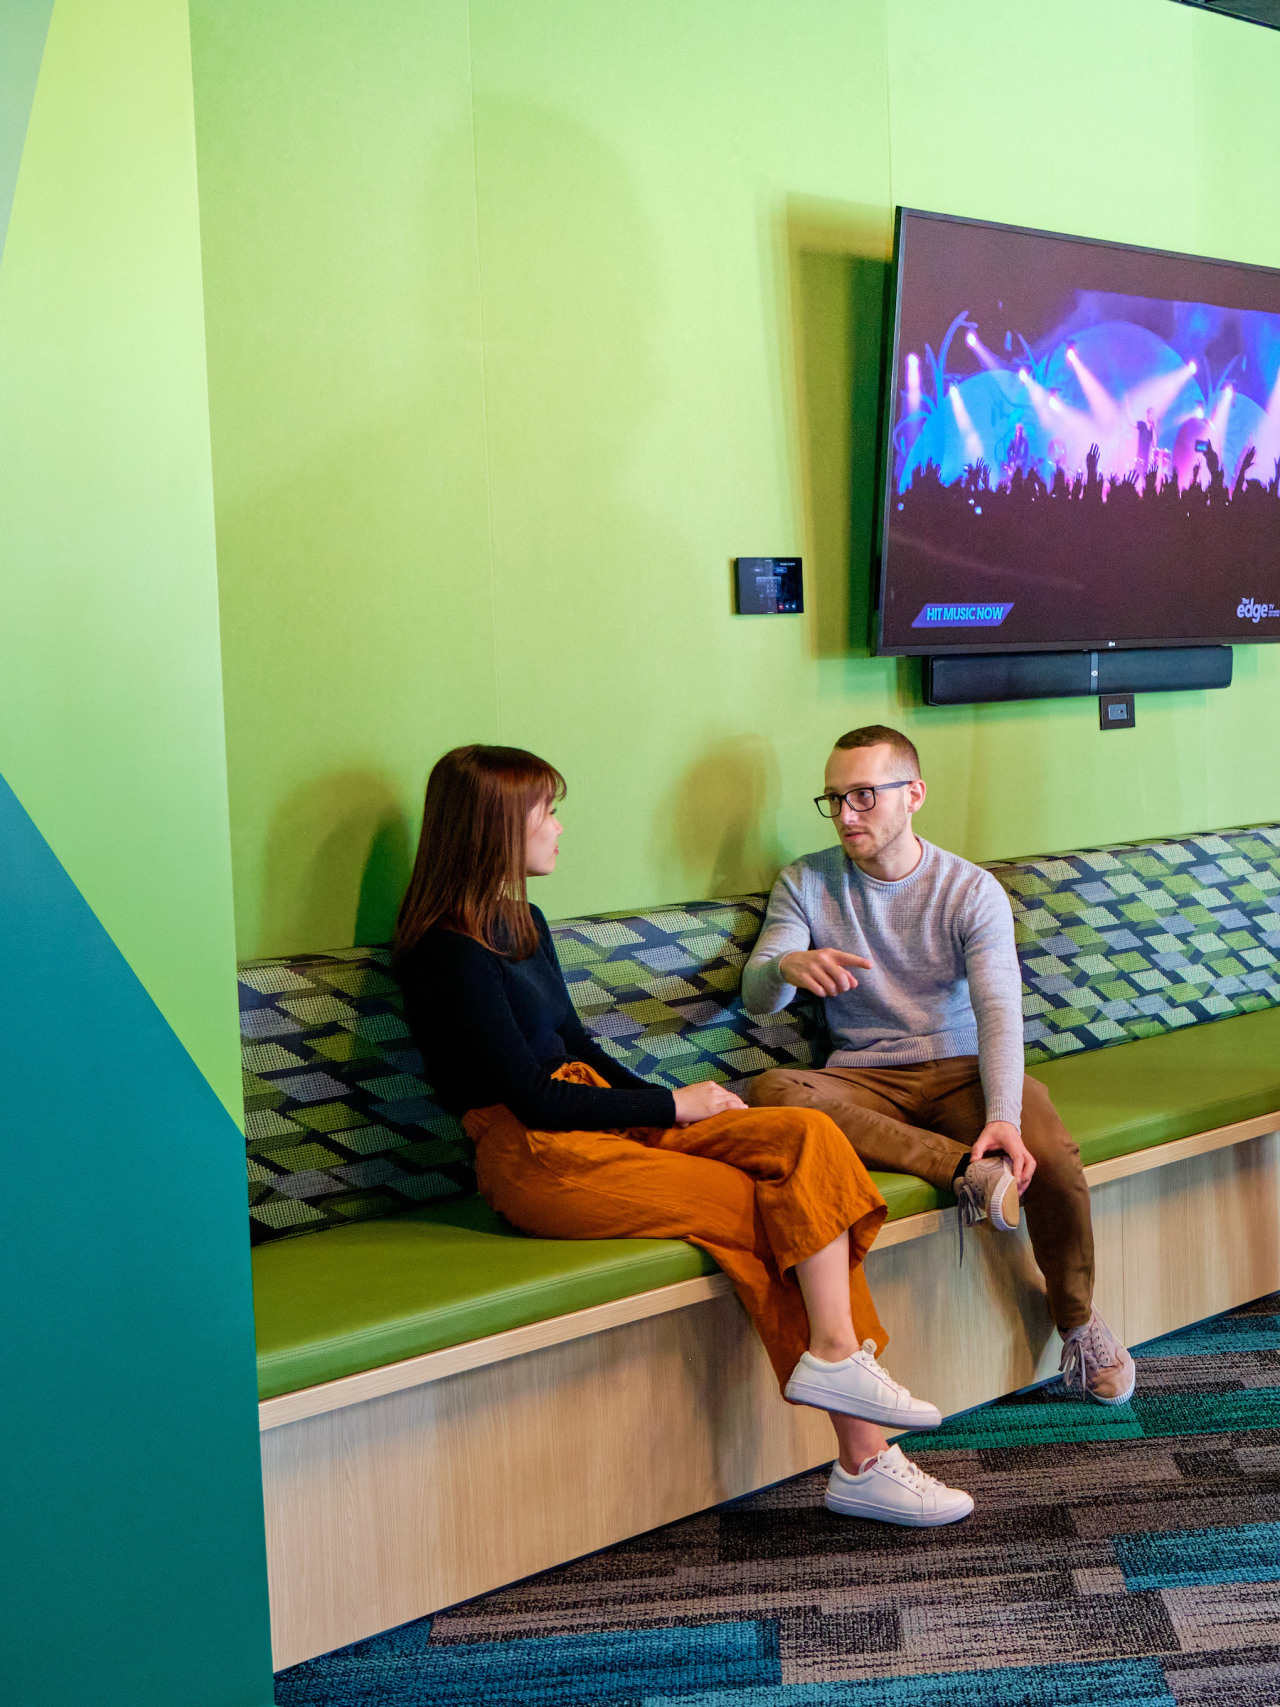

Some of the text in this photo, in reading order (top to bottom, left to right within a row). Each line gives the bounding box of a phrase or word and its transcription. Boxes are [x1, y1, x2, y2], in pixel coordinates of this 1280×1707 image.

[926, 607, 1003, 620] HIT MUSIC NOW
[1237, 597, 1268, 623] edge
